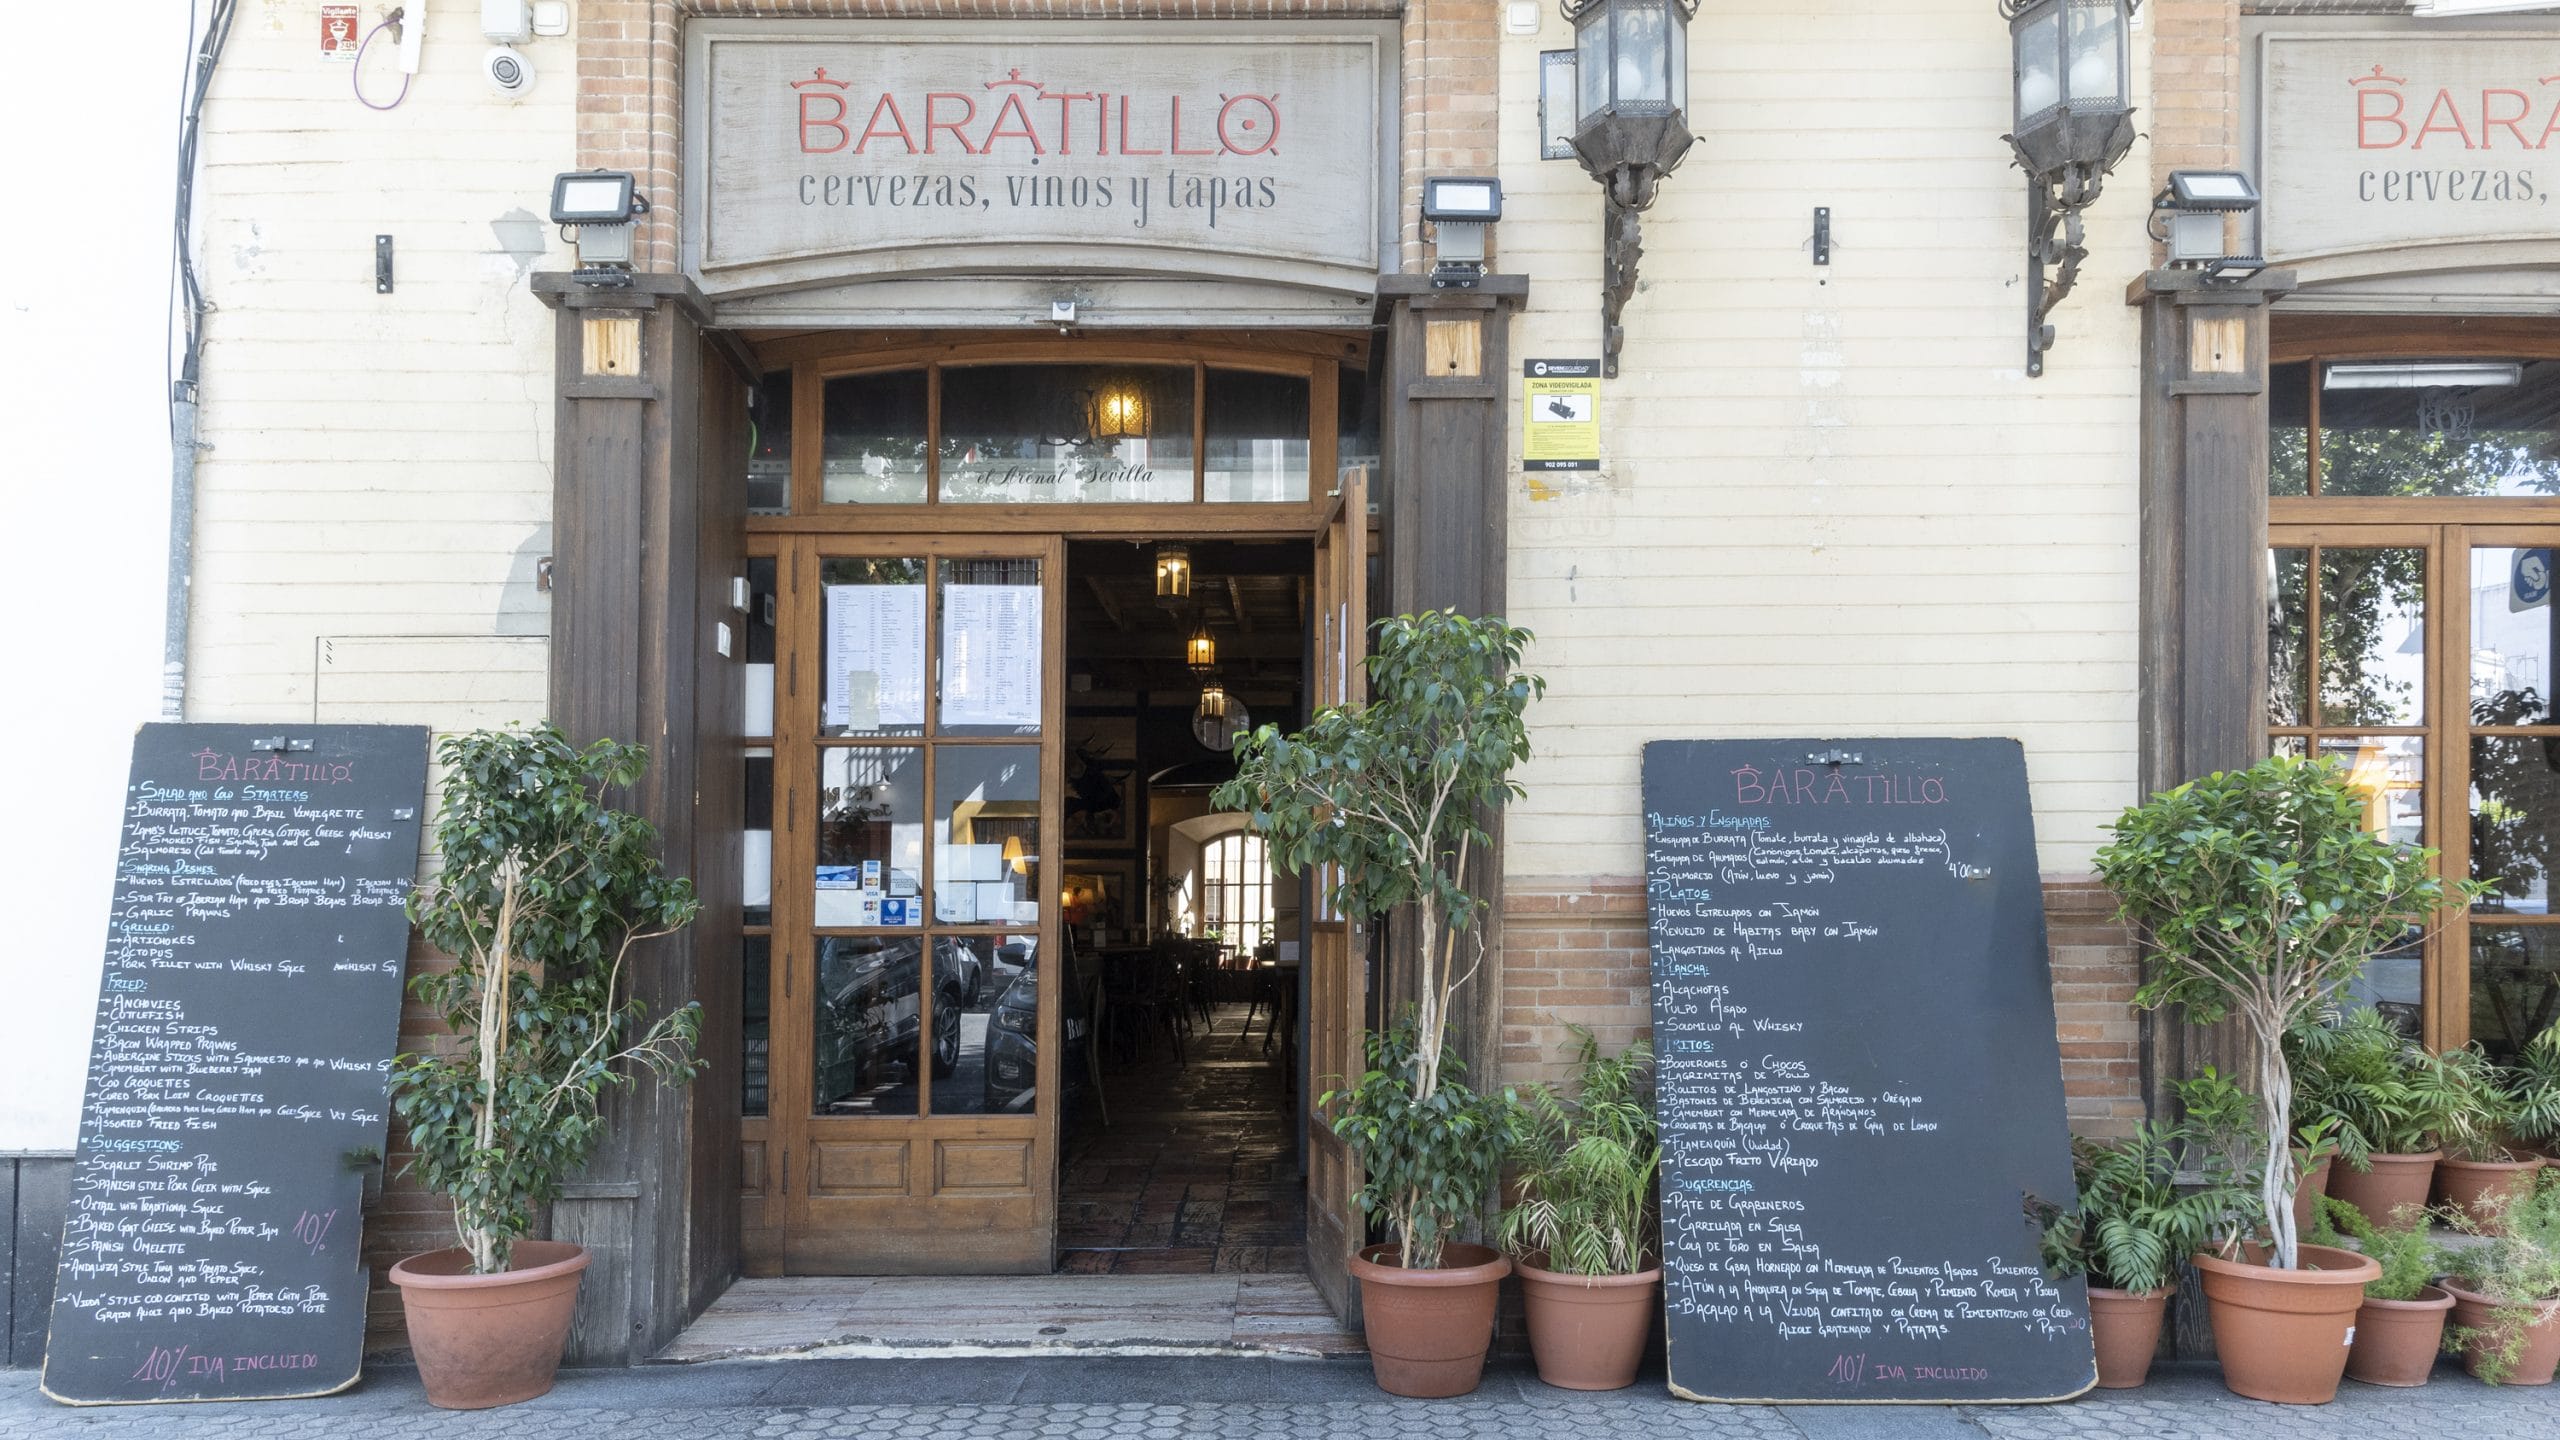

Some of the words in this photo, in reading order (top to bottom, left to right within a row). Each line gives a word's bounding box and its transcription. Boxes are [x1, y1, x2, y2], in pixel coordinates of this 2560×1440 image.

[322, 7, 357, 16] Vigilante
[798, 88, 1281, 156] BARATILLO
[799, 173, 991, 213] cervezas,
[1006, 158, 1113, 208] vinos
[1131, 175, 1150, 229] y
[1166, 169, 1275, 229] tapas
[2359, 169, 2548, 205] cervezas,
[1000, 465, 1067, 484] Arenal
[1085, 462, 1155, 484] Sevilla
[198, 752, 352, 784] BARATILLO
[1738, 770, 1949, 805] BARATILLO
[189, 804, 227, 821] TOMATO
[231, 808, 248, 822] AND
[252, 805, 285, 821] BASIL
[1702, 832, 1747, 848] BURRATA
[1830, 836, 1840, 851] y
[1886, 831, 1897, 843] de
[1692, 854, 1705, 863] DE
[126, 905, 173, 920] GARLIC
[1655, 919, 1705, 936] REVUELTO
[1713, 925, 1726, 936] DE
[1733, 921, 1781, 943] HABITAS
[121, 946, 173, 958] OCTOPUS
[1659, 940, 1726, 962] LANGOSTINOS
[1730, 945, 1742, 962] AL
[150, 957, 191, 969] FILLET
[230, 957, 272, 972] WHISKY
[113, 994, 181, 1012] ANCHOVIES
[109, 1021, 160, 1034] CHICKEN
[166, 1021, 218, 1036] STRIPS
[1729, 1022, 1744, 1039] AL
[1752, 1018, 1803, 1032] WHISKY
[1761, 1054, 1806, 1071] CHOCOS
[1667, 1071, 1742, 1085] LAGRIMITAS
[146, 1154, 193, 1171] SHRIMP
[1674, 1150, 1722, 1174] PESCADO
[1725, 1153, 1761, 1167] FRITO
[1767, 1150, 1819, 1176] VARIADO
[1710, 1200, 1723, 1210] DE
[293, 1208, 337, 1256] 10%
[1678, 1213, 1743, 1239] CARRILLADA
[1748, 1222, 1761, 1232] EN
[1768, 1216, 1803, 1242] SALSA
[1706, 1242, 1721, 1252] DE
[1758, 1242, 1772, 1252] EN
[1781, 1238, 1820, 1261] SALSA
[1756, 1258, 1801, 1280] HORNEADO
[145, 1294, 164, 1304] COD
[1718, 1284, 1725, 1300] A
[1680, 1297, 1738, 1323] BACALAO
[1743, 1304, 1753, 1322] A
[1759, 1305, 1773, 1324] LA
[132, 1344, 189, 1392] 10%
[187, 1355, 224, 1384] IVA
[232, 1354, 318, 1371] INCLUIDO
[1828, 1353, 1865, 1389] 10%
[1875, 1364, 1907, 1382] IVA
[1914, 1366, 1988, 1381] INCLUIDO
